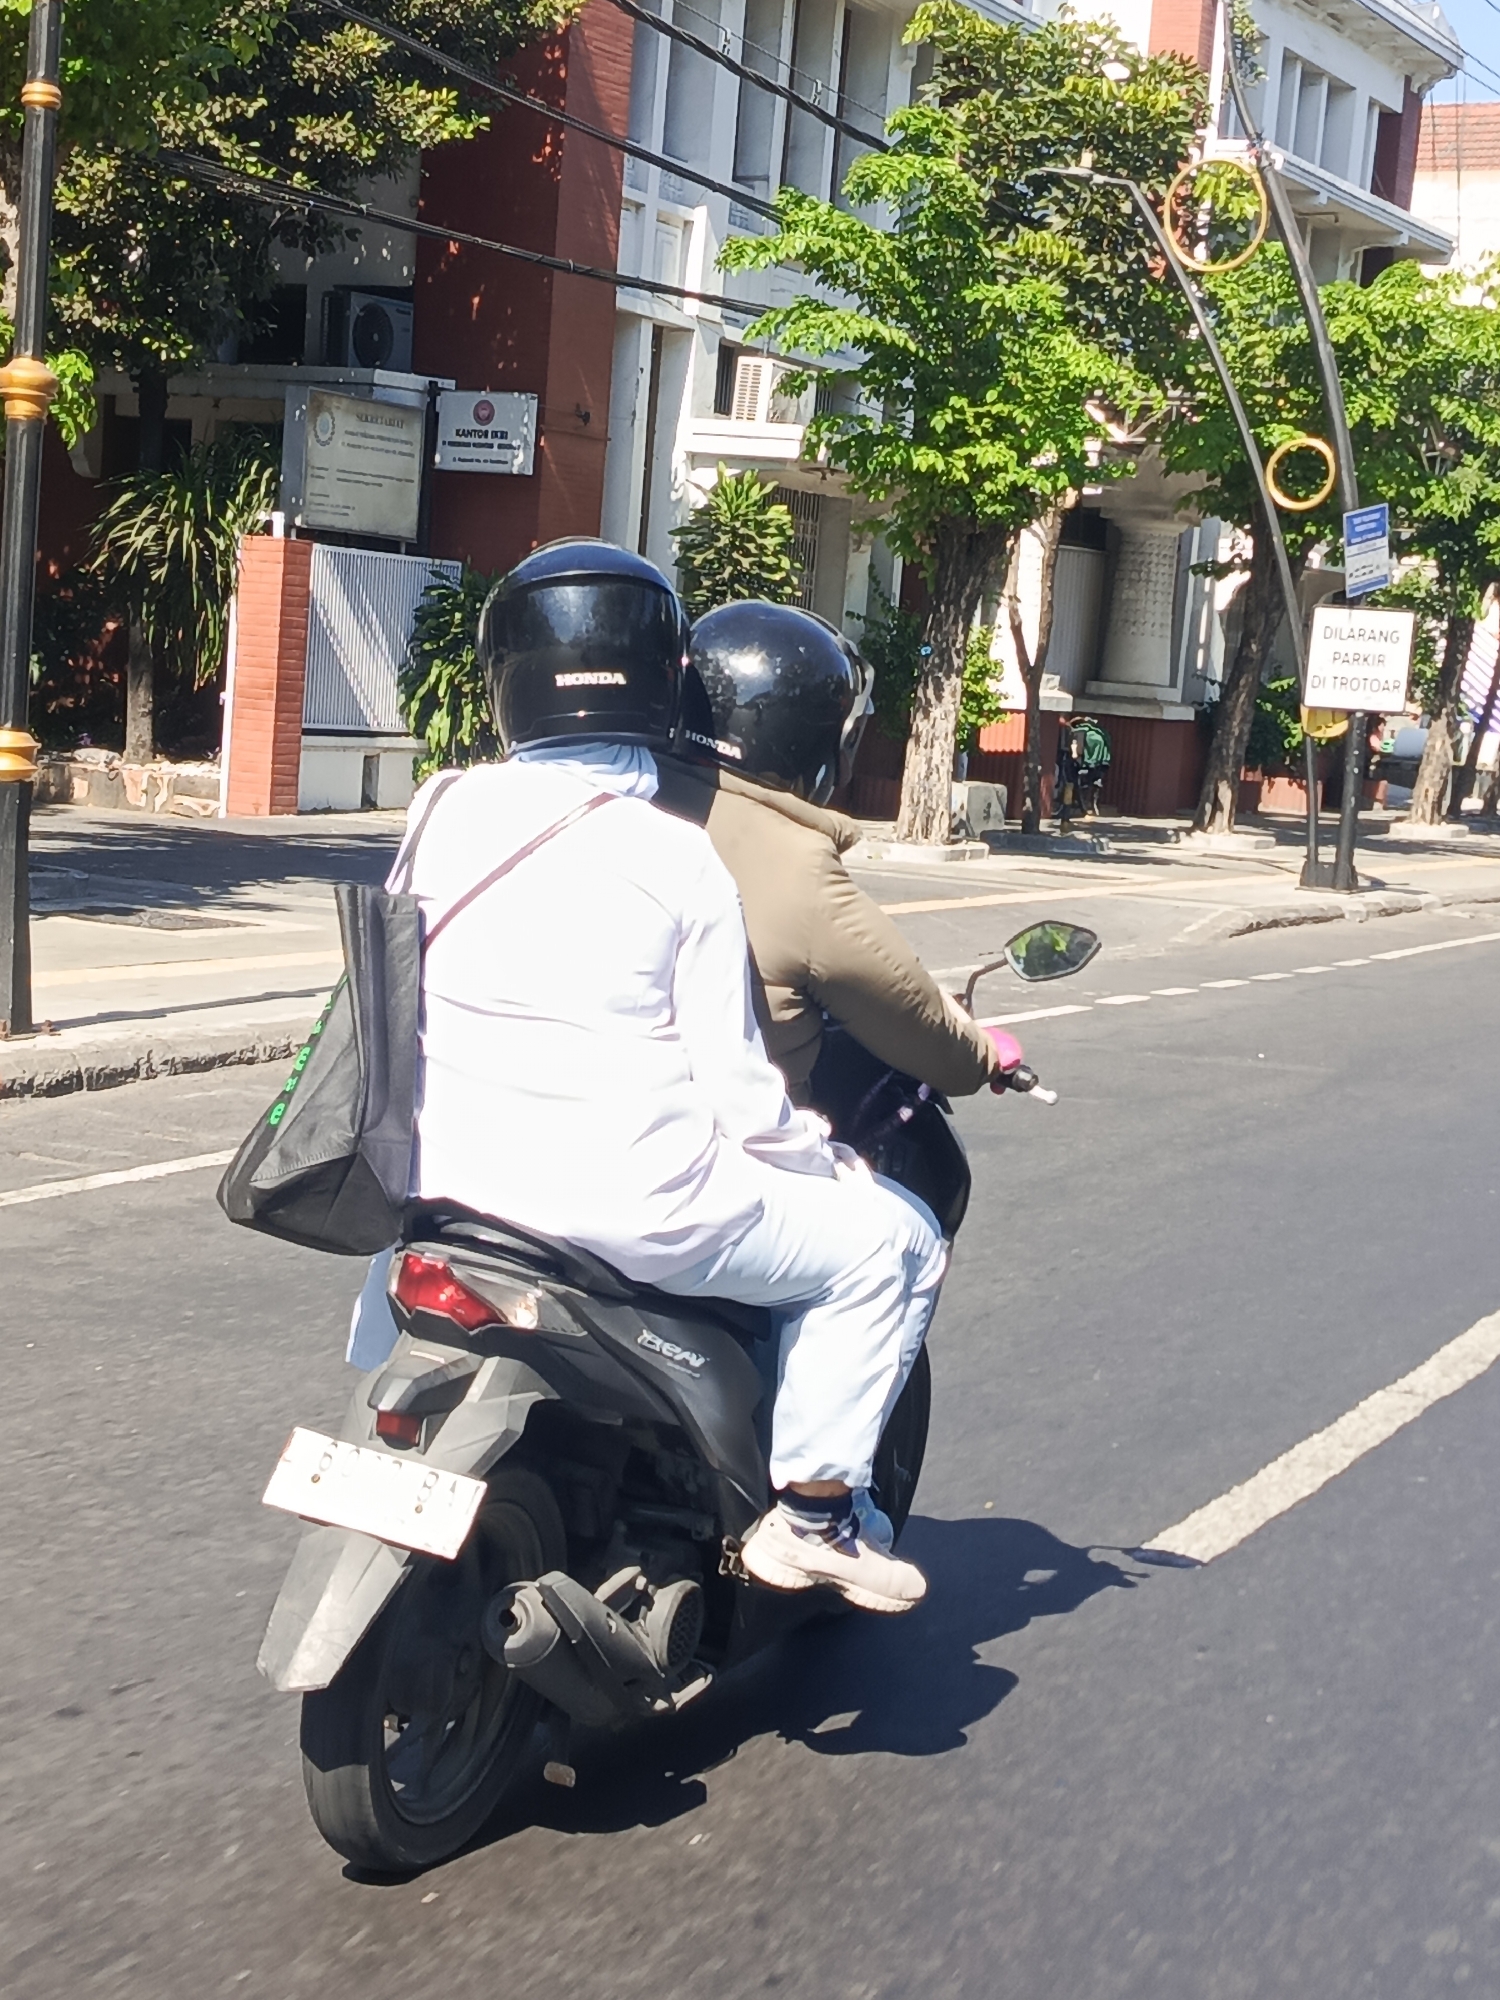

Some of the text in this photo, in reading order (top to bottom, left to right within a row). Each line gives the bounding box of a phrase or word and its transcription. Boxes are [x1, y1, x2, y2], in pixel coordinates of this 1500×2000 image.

[455, 428, 489, 439] KANTOR
[1323, 625, 1400, 644] DILARANG
[1332, 651, 1386, 667] PARKIR
[555, 671, 627, 687] HONDA
[1311, 675, 1401, 693] DI TROTOAR
[685, 729, 742, 760] HONDA
